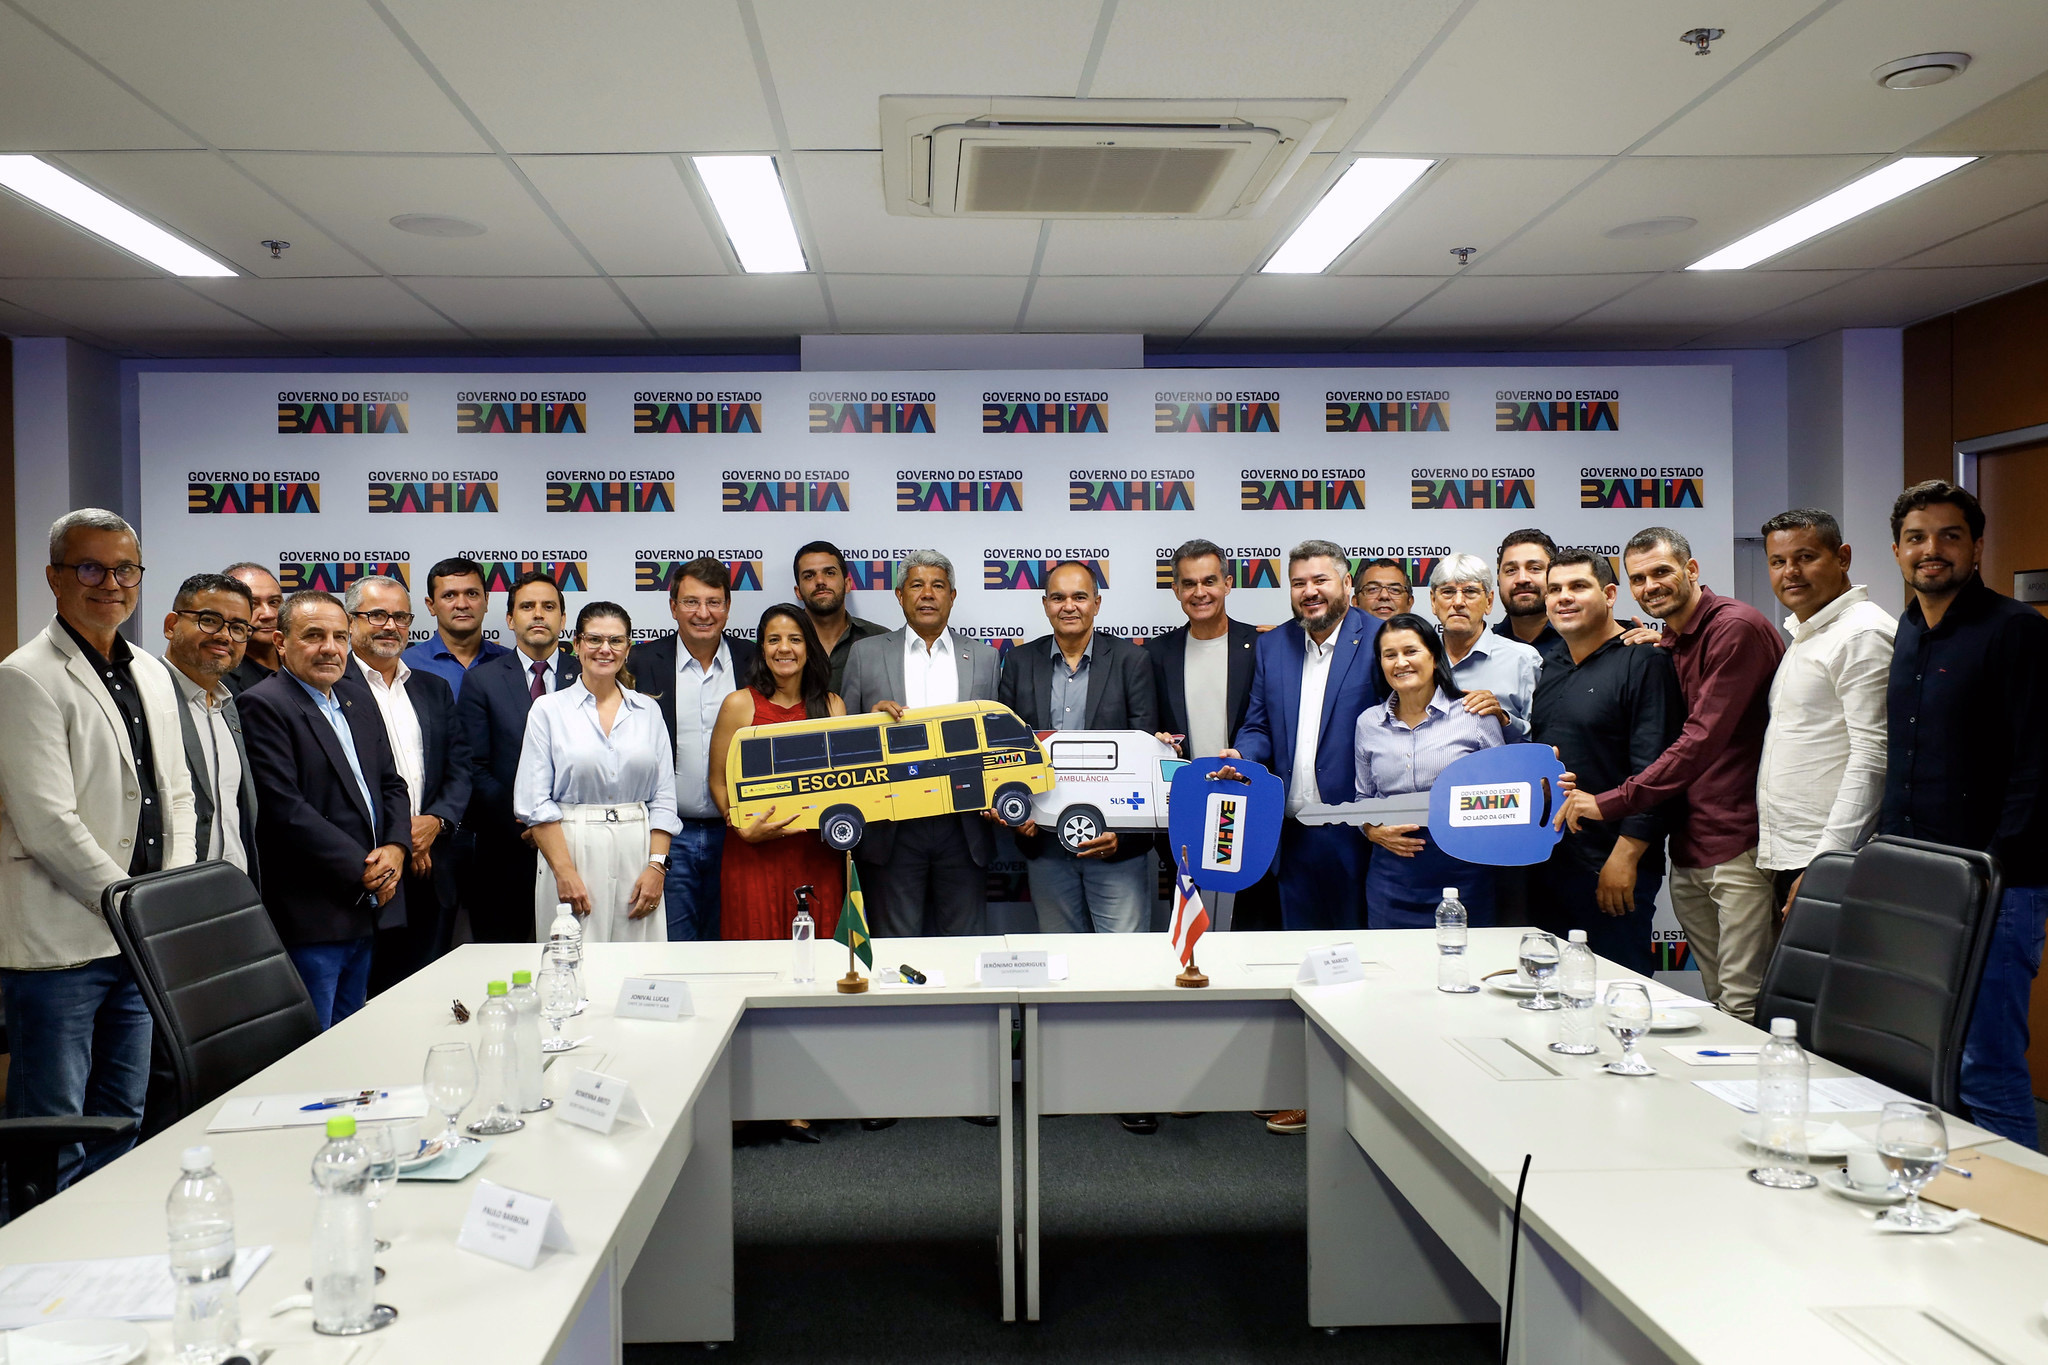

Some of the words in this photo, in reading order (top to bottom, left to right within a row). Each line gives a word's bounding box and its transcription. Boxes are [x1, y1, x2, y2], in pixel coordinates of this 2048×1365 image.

[278, 392, 338, 401] GOVERNO
[342, 392, 359, 401] DO
[363, 392, 408, 401] ESTADO
[457, 392, 517, 401] GOVERNO
[520, 392, 537, 401] DO
[541, 392, 586, 401] ESTADO
[634, 392, 693, 401] GOVERNO
[697, 392, 713, 401] DO
[717, 392, 762, 401] ESTADO
[809, 392, 867, 401] GOVERNO
[871, 392, 888, 401] DO
[892, 392, 936, 401] ESTADO
[983, 392, 1040, 402] GOVERNO
[1044, 392, 1061, 402] DO
[1065, 392, 1108, 402] ESTADO
[1155, 392, 1212, 401] GOVERNO
[1216, 392, 1232, 401] DO
[1236, 392, 1280, 401] ESTADO
[1326, 391, 1383, 400] GOVERNO
[1386, 391, 1403, 400] DO
[1406, 391, 1450, 400] ESTADO
[1496, 390, 1552, 400] GOVERNO
[1556, 390, 1572, 400] DO
[1576, 390, 1619, 400] ESTADO
[278, 403, 408, 433] BAHIA
[457, 403, 586, 433] BAHIA
[634, 403, 762, 433] BAHIA
[809, 403, 936, 433] BAHIA
[983, 403, 1108, 433] BAHIA
[1155, 403, 1280, 432] BAHIA
[1326, 403, 1450, 432] BAHIA
[1496, 402, 1619, 431] BAHIA
[188, 472, 249, 481] GOVERNO
[253, 472, 270, 481] DO
[274, 472, 320, 481] ESTADO
[368, 471, 428, 481] GOVERNO
[432, 471, 449, 481] DO
[453, 471, 498, 481] ESTADO
[546, 471, 605, 480] GOVERNO
[609, 471, 626, 480] DO
[630, 471, 675, 480] ESTADO
[722, 471, 781, 480] GOVERNO
[785, 471, 801, 480] DO
[805, 471, 849, 480] ESTADO
[897, 470, 955, 480] GOVERNO
[958, 470, 975, 480] DO
[979, 470, 1023, 480] ESTADO
[1069, 470, 1127, 480] GOVERNO
[1131, 470, 1147, 480] DO
[1151, 470, 1195, 480] ESTADO
[1241, 469, 1298, 479] GOVERNO
[1302, 469, 1318, 479] DO
[1322, 469, 1365, 479] ESTADO
[1412, 468, 1468, 478] GOVERNO
[1472, 468, 1488, 478] DO
[1492, 468, 1535, 478] ESTADO
[1581, 467, 1637, 477] GOVERNO
[1641, 467, 1657, 477] DO
[1661, 467, 1703, 477] ESTADO
[188, 483, 320, 513] BAHIA
[368, 483, 498, 512] BAHIA
[546, 482, 675, 512] BAHIA
[722, 482, 849, 511] BAHIA
[897, 482, 1023, 511] BAHIA
[1069, 481, 1195, 511] BAHIA
[1241, 481, 1365, 510] BAHIA
[1412, 480, 1535, 509] BAHIA
[1581, 479, 1703, 508] BAHIA
[279, 551, 339, 561] GOVERNO
[343, 551, 361, 561] DO
[364, 551, 410, 561] ESTADO
[458, 551, 518, 561] GOVERNO
[521, 551, 539, 561] DO
[542, 551, 587, 561] ESTADO
[635, 550, 694, 560] GOVERNO
[697, 550, 714, 559] DO
[718, 550, 763, 560] ESTADO
[872, 549, 889, 560] DO
[984, 548, 1042, 559] GOVERNO
[1045, 548, 1062, 559] DO
[1066, 548, 1110, 559] ESTADO
[1237, 548, 1281, 558] ESTADO
[1344, 547, 1384, 556] VERNO
[1388, 547, 1404, 556] DO
[1407, 546, 1451, 556] ESTADO
[984, 560, 1109, 590] BAA
[724, 628, 756, 638] GOVE
[960, 627, 976, 637] DO
[980, 627, 1024, 637] ESTADO
[1095, 626, 1129, 636] ERNO
[1132, 626, 1149, 636] DO
[982, 753, 1025, 767] BAHIA
[797, 767, 890, 793] ESCOLAR
[1058, 774, 1110, 783] AMBULÂNCIA
[1461, 789, 1488, 797] GOVERNO
[1110, 797, 1125, 805] SUS
[1460, 794, 1520, 811] BAHIA
[1216, 800, 1236, 865] BAHIA
[630, 994, 652, 1002] JONIVAL
[652, 995, 670, 1003] LUCAS
